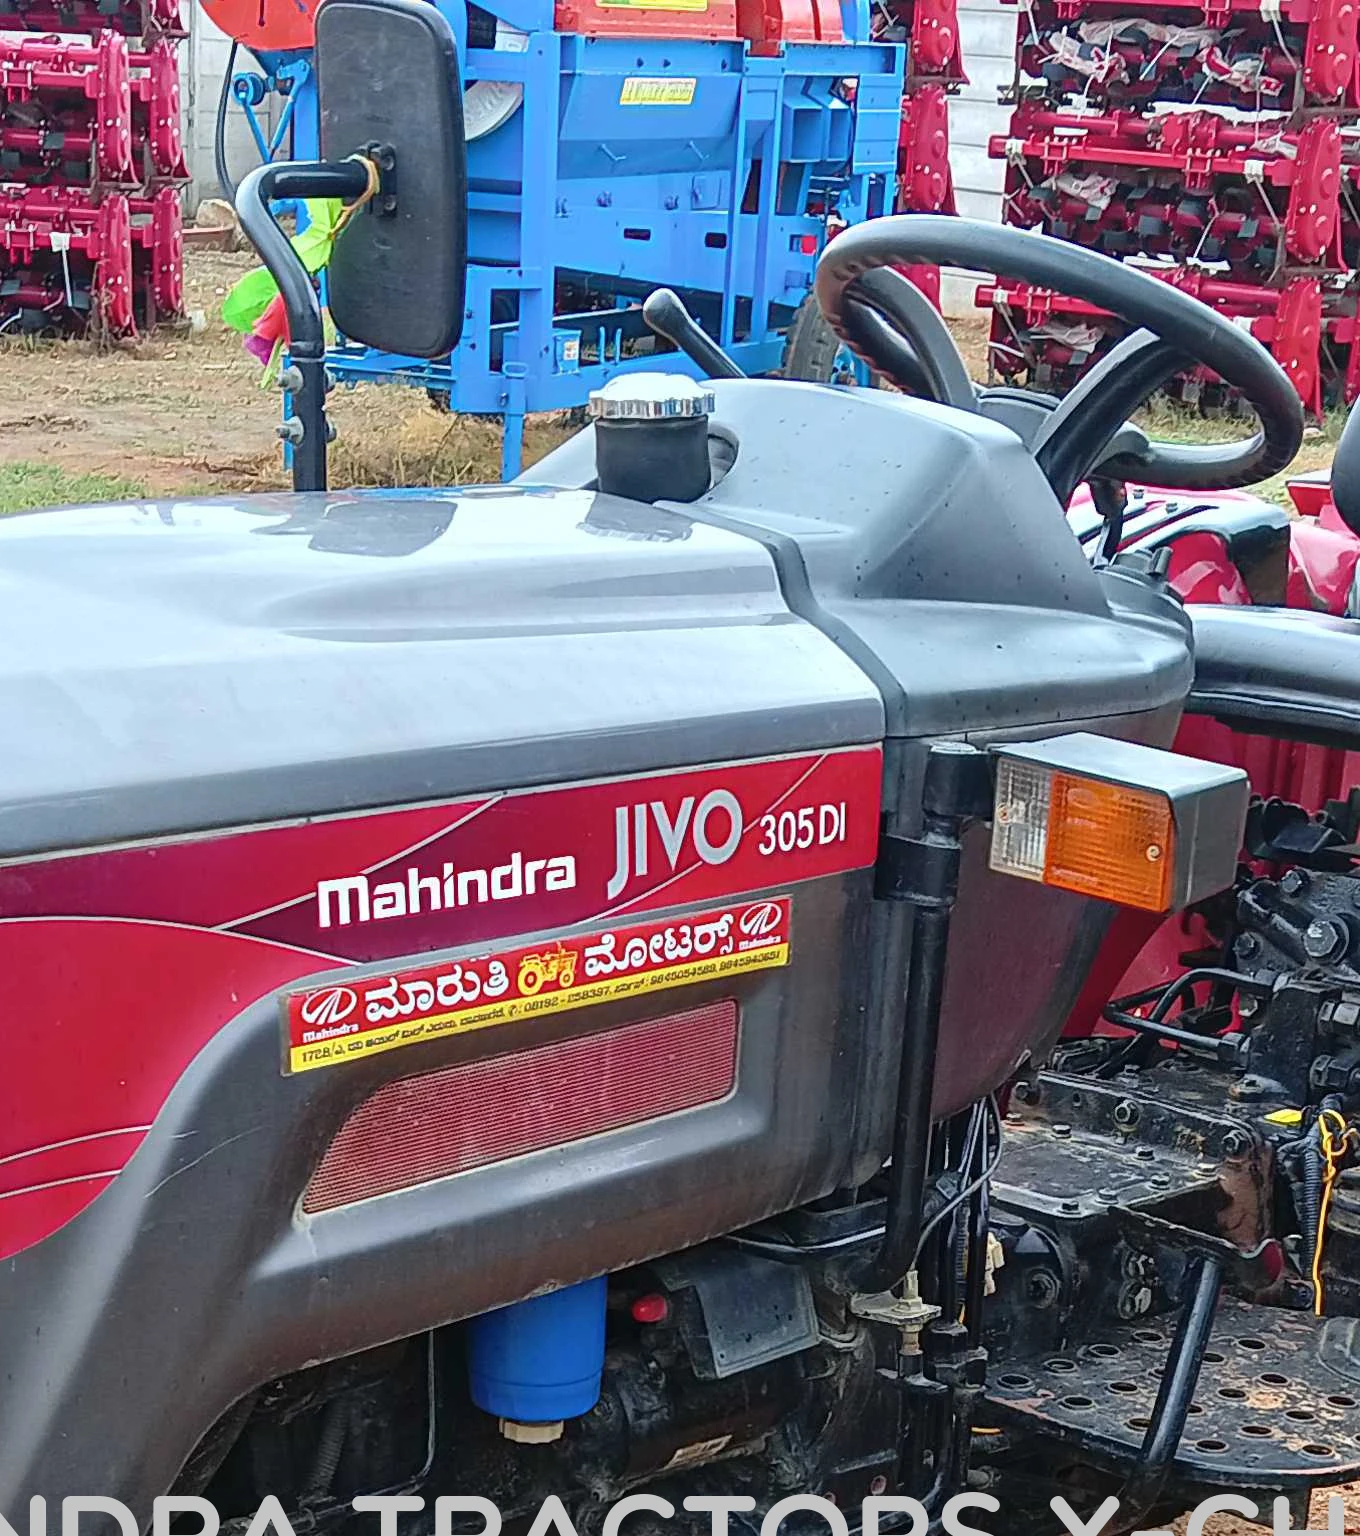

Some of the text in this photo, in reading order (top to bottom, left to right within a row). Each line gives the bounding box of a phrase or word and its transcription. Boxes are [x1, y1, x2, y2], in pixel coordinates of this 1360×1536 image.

[318, 852, 576, 928] Mahindra
[607, 789, 743, 900] JIVO
[365, 961, 510, 1023] ಮಾರುತಿ
